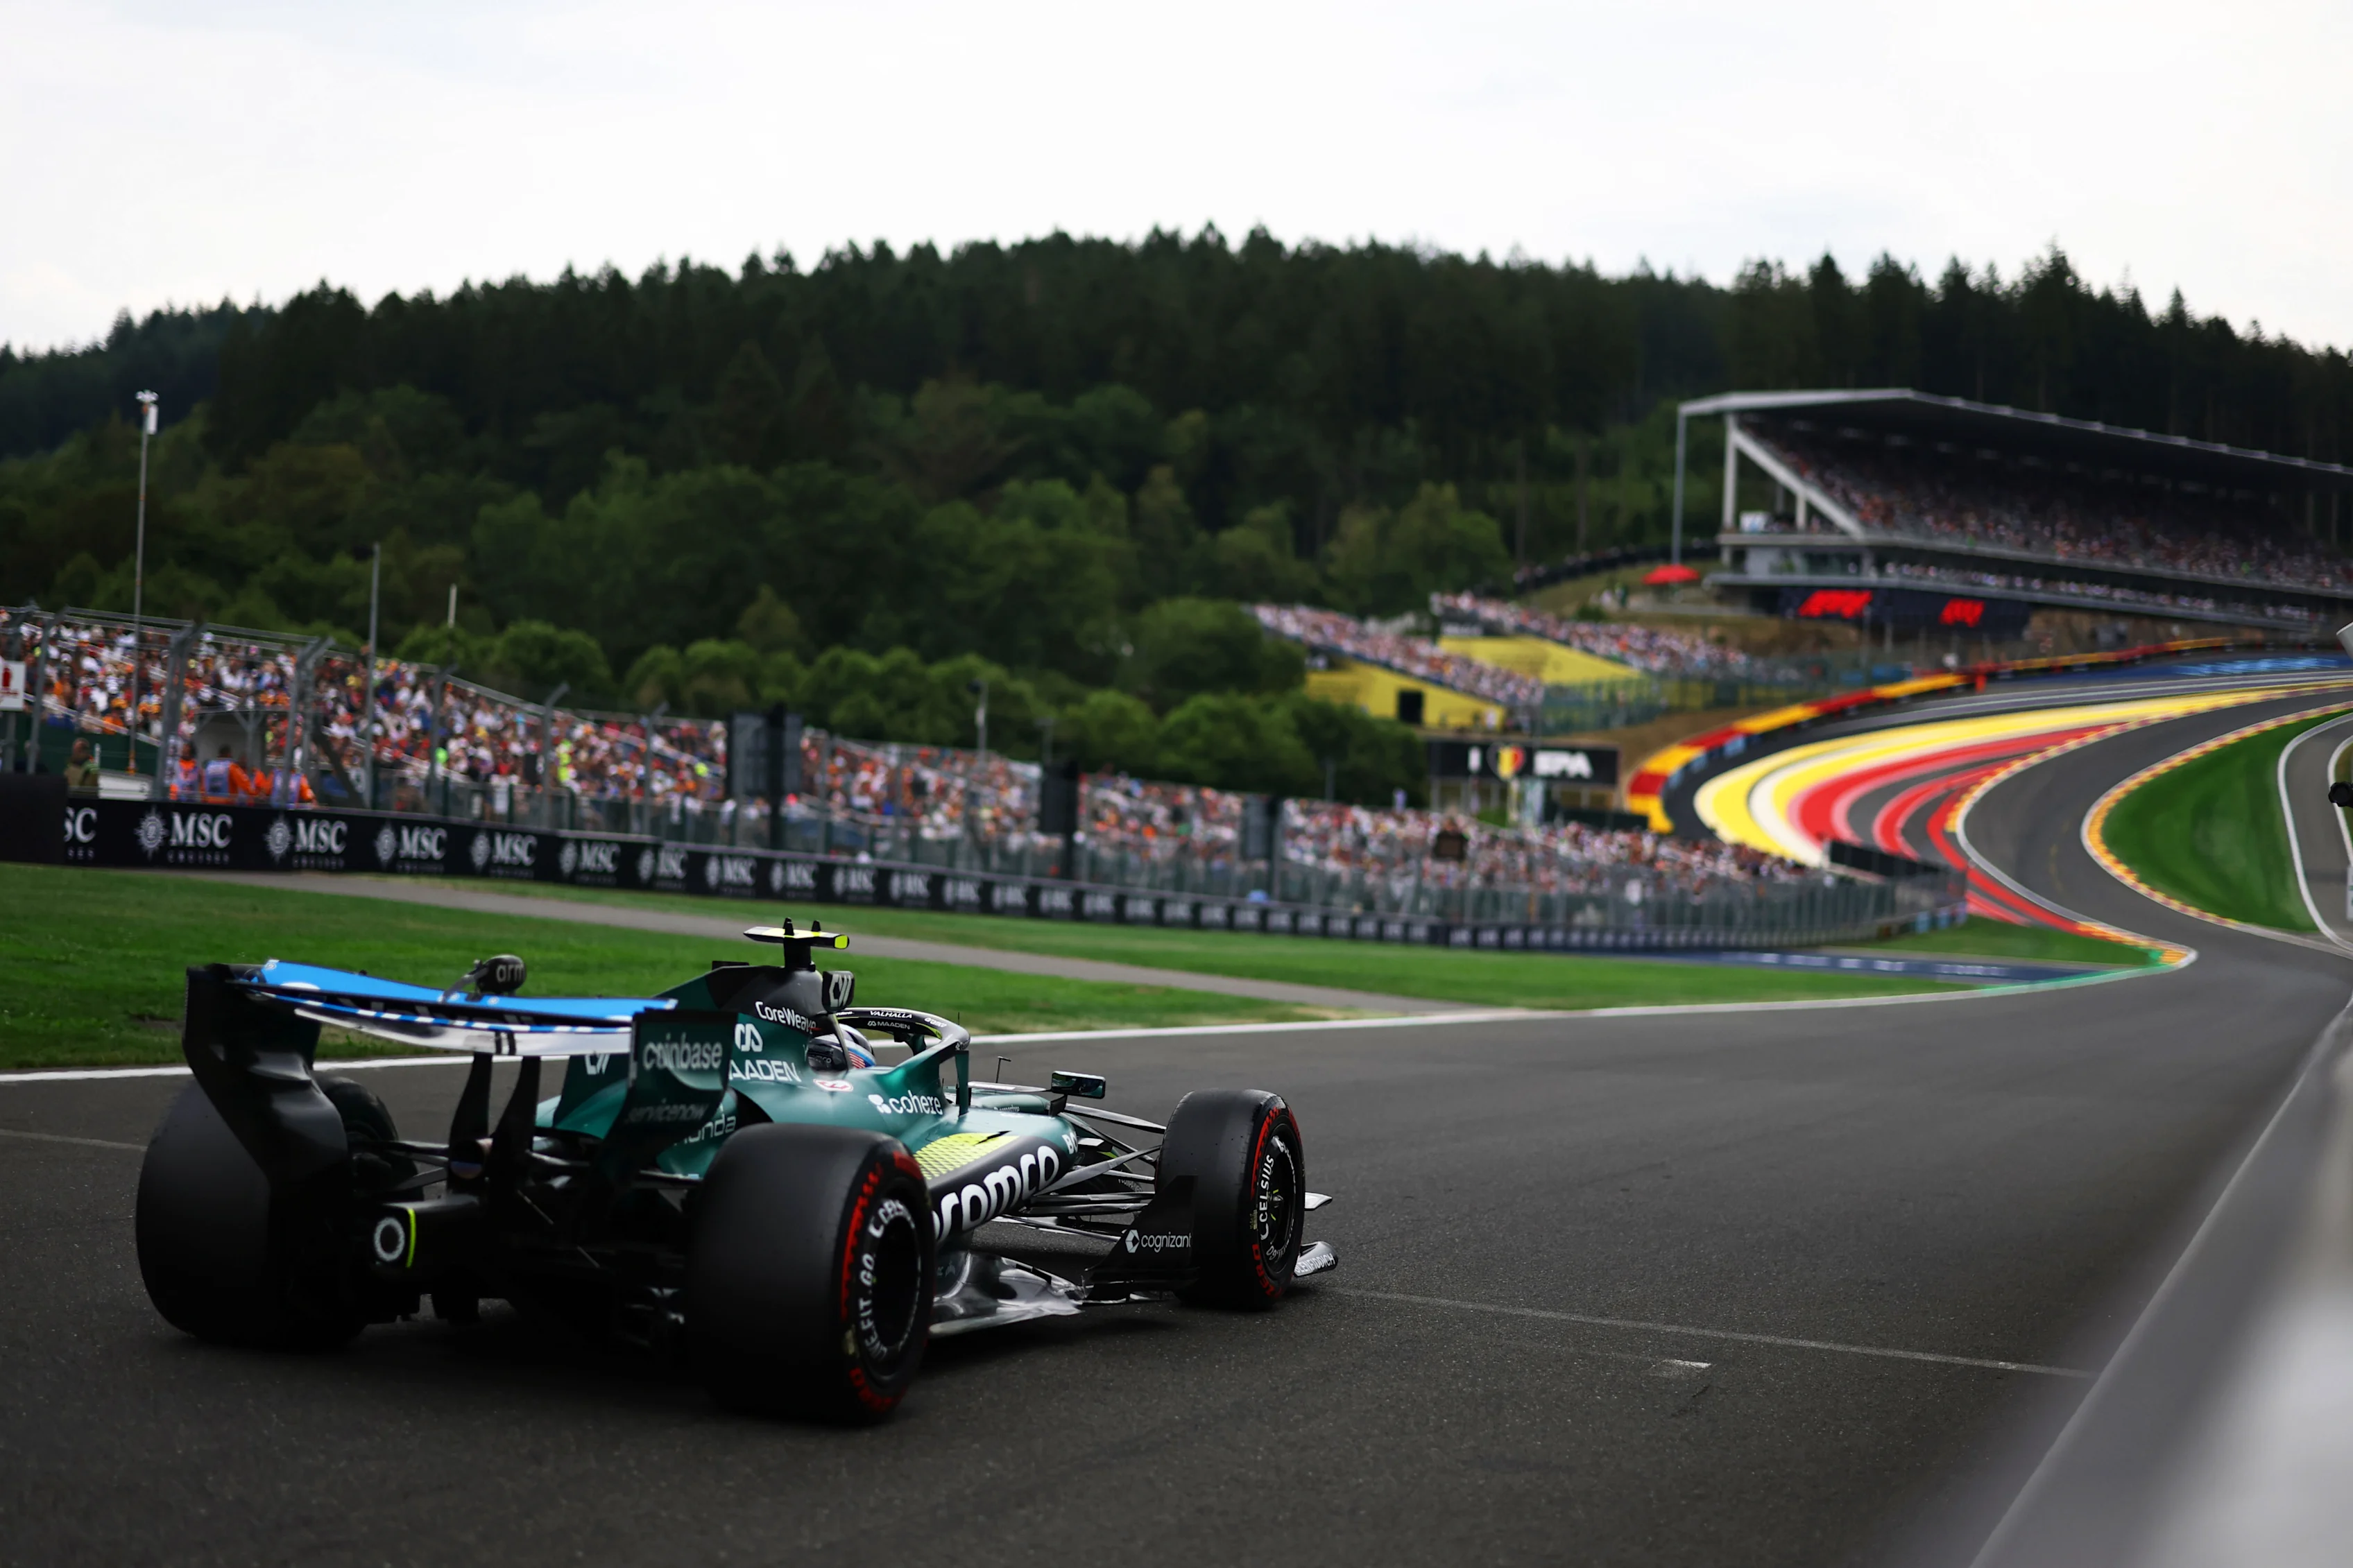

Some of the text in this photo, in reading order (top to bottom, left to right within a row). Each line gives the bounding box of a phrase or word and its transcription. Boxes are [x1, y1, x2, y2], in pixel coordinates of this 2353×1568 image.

[169, 811, 233, 849] MSC
[294, 818, 348, 854] MSC
[398, 825, 448, 860] MSC
[491, 832, 538, 866] MSC
[497, 964, 524, 983] arm
[755, 1001, 816, 1035] CoreWeave
[870, 1010, 913, 1019] VALHALLA
[877, 1021, 910, 1030] MAADEN
[642, 1032, 723, 1070] coinbase
[728, 1059, 802, 1083] AADEN
[889, 1090, 943, 1115] cohere
[1258, 1154, 1275, 1223] CELSIUS
[1140, 1231, 1192, 1252] cognizant
[1294, 1252, 1336, 1273] GLENFIDDICH
